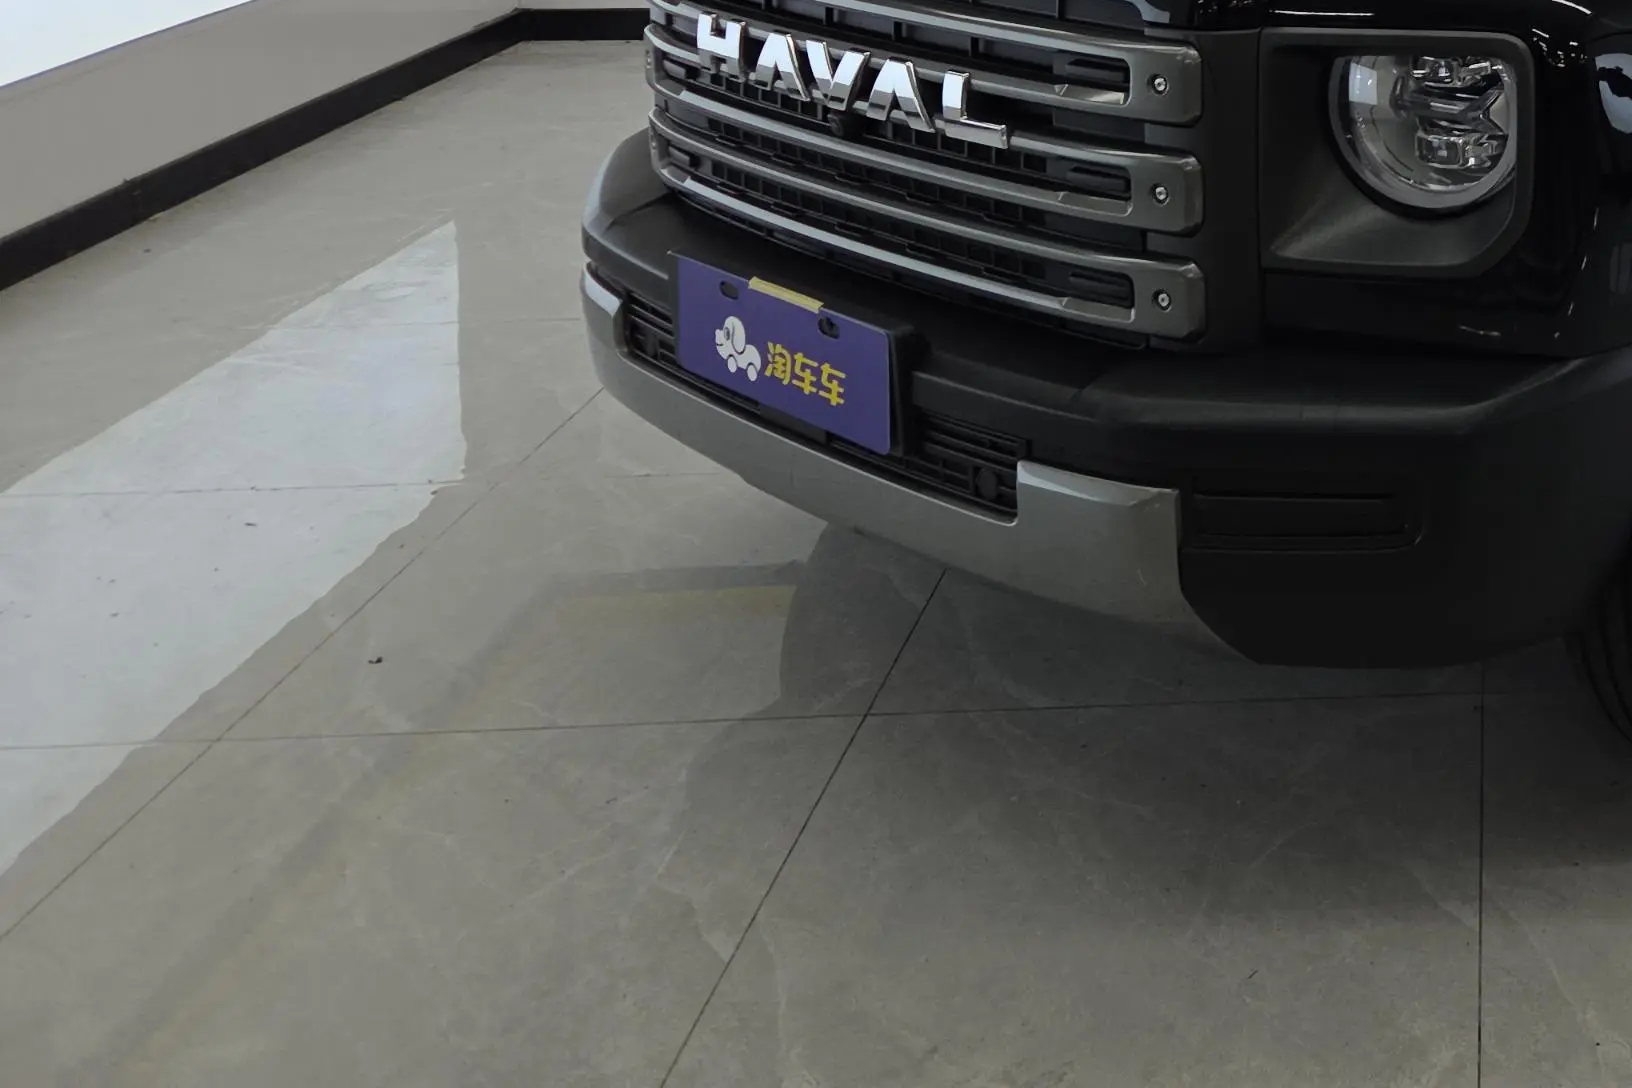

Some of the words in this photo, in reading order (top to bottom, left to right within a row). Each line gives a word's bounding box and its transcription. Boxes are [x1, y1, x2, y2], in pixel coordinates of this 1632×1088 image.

[697, 13, 1010, 149] HAVAL
[764, 341, 846, 406] 淘车车
